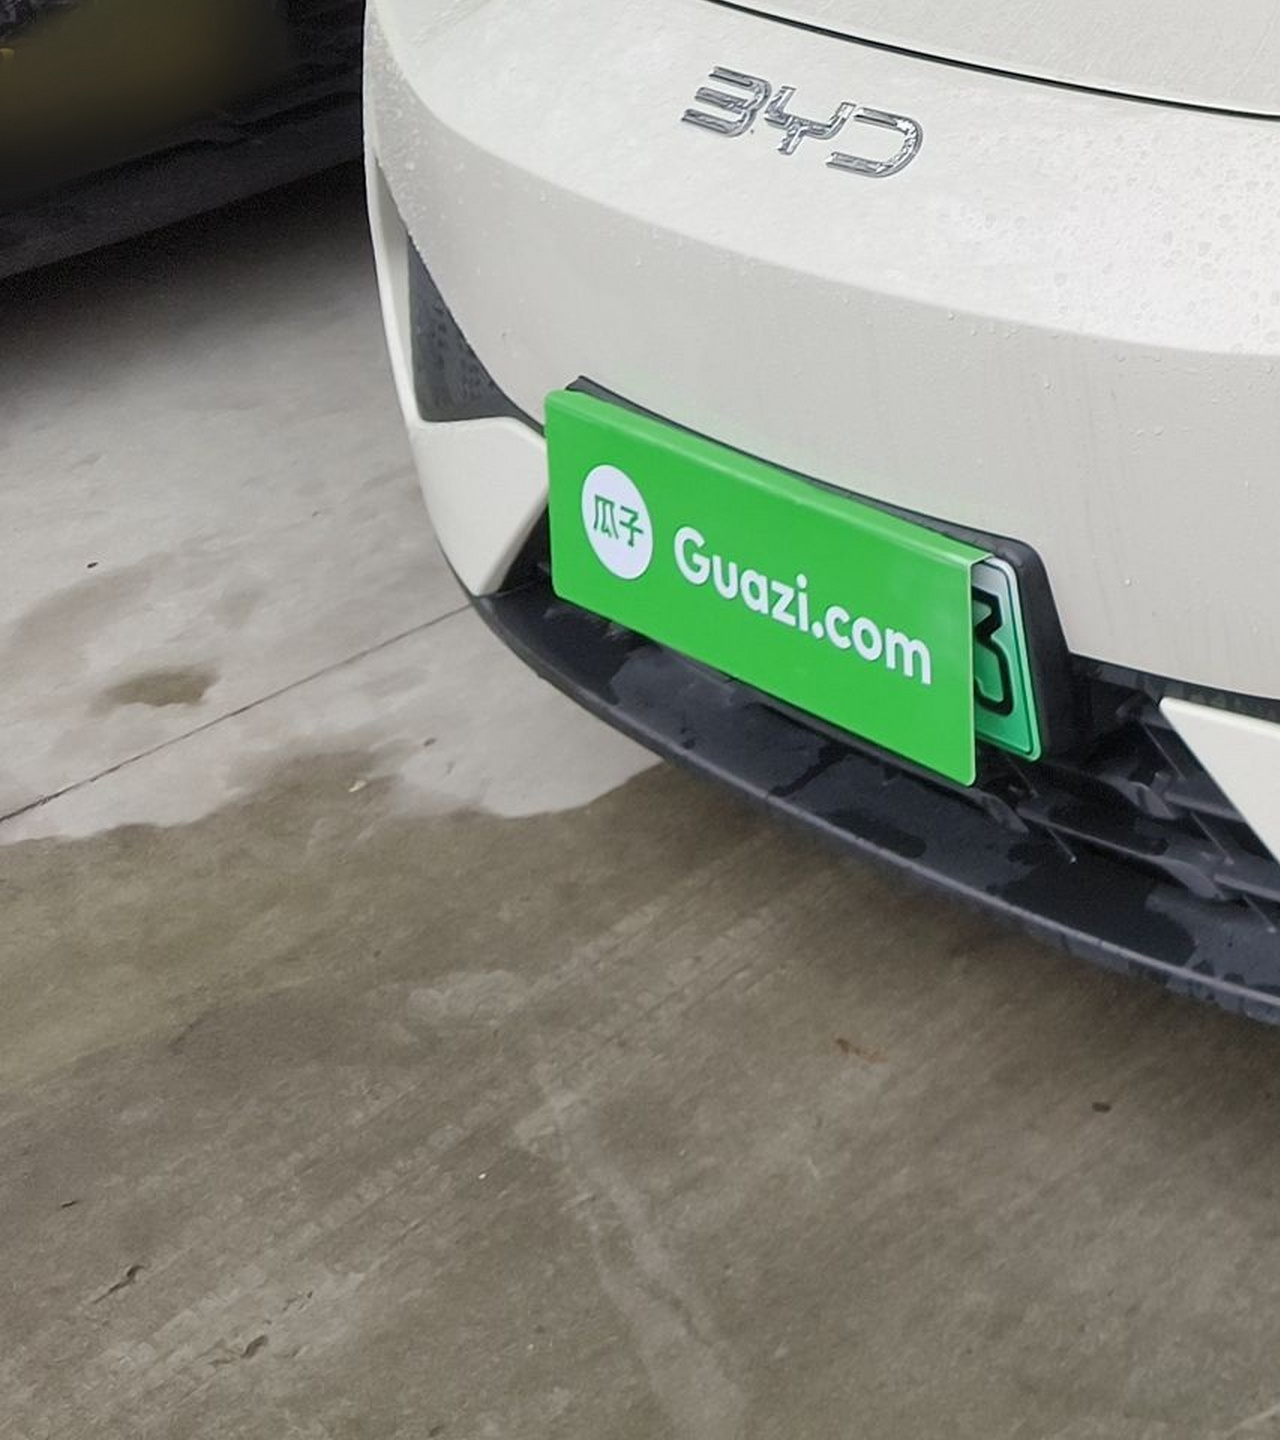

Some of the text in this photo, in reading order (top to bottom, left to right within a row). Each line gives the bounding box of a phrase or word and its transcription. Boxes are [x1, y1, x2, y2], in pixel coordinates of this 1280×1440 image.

[681, 66, 923, 178] BYD
[593, 494, 644, 548] 瓜子
[673, 525, 932, 685] Guazi.com
